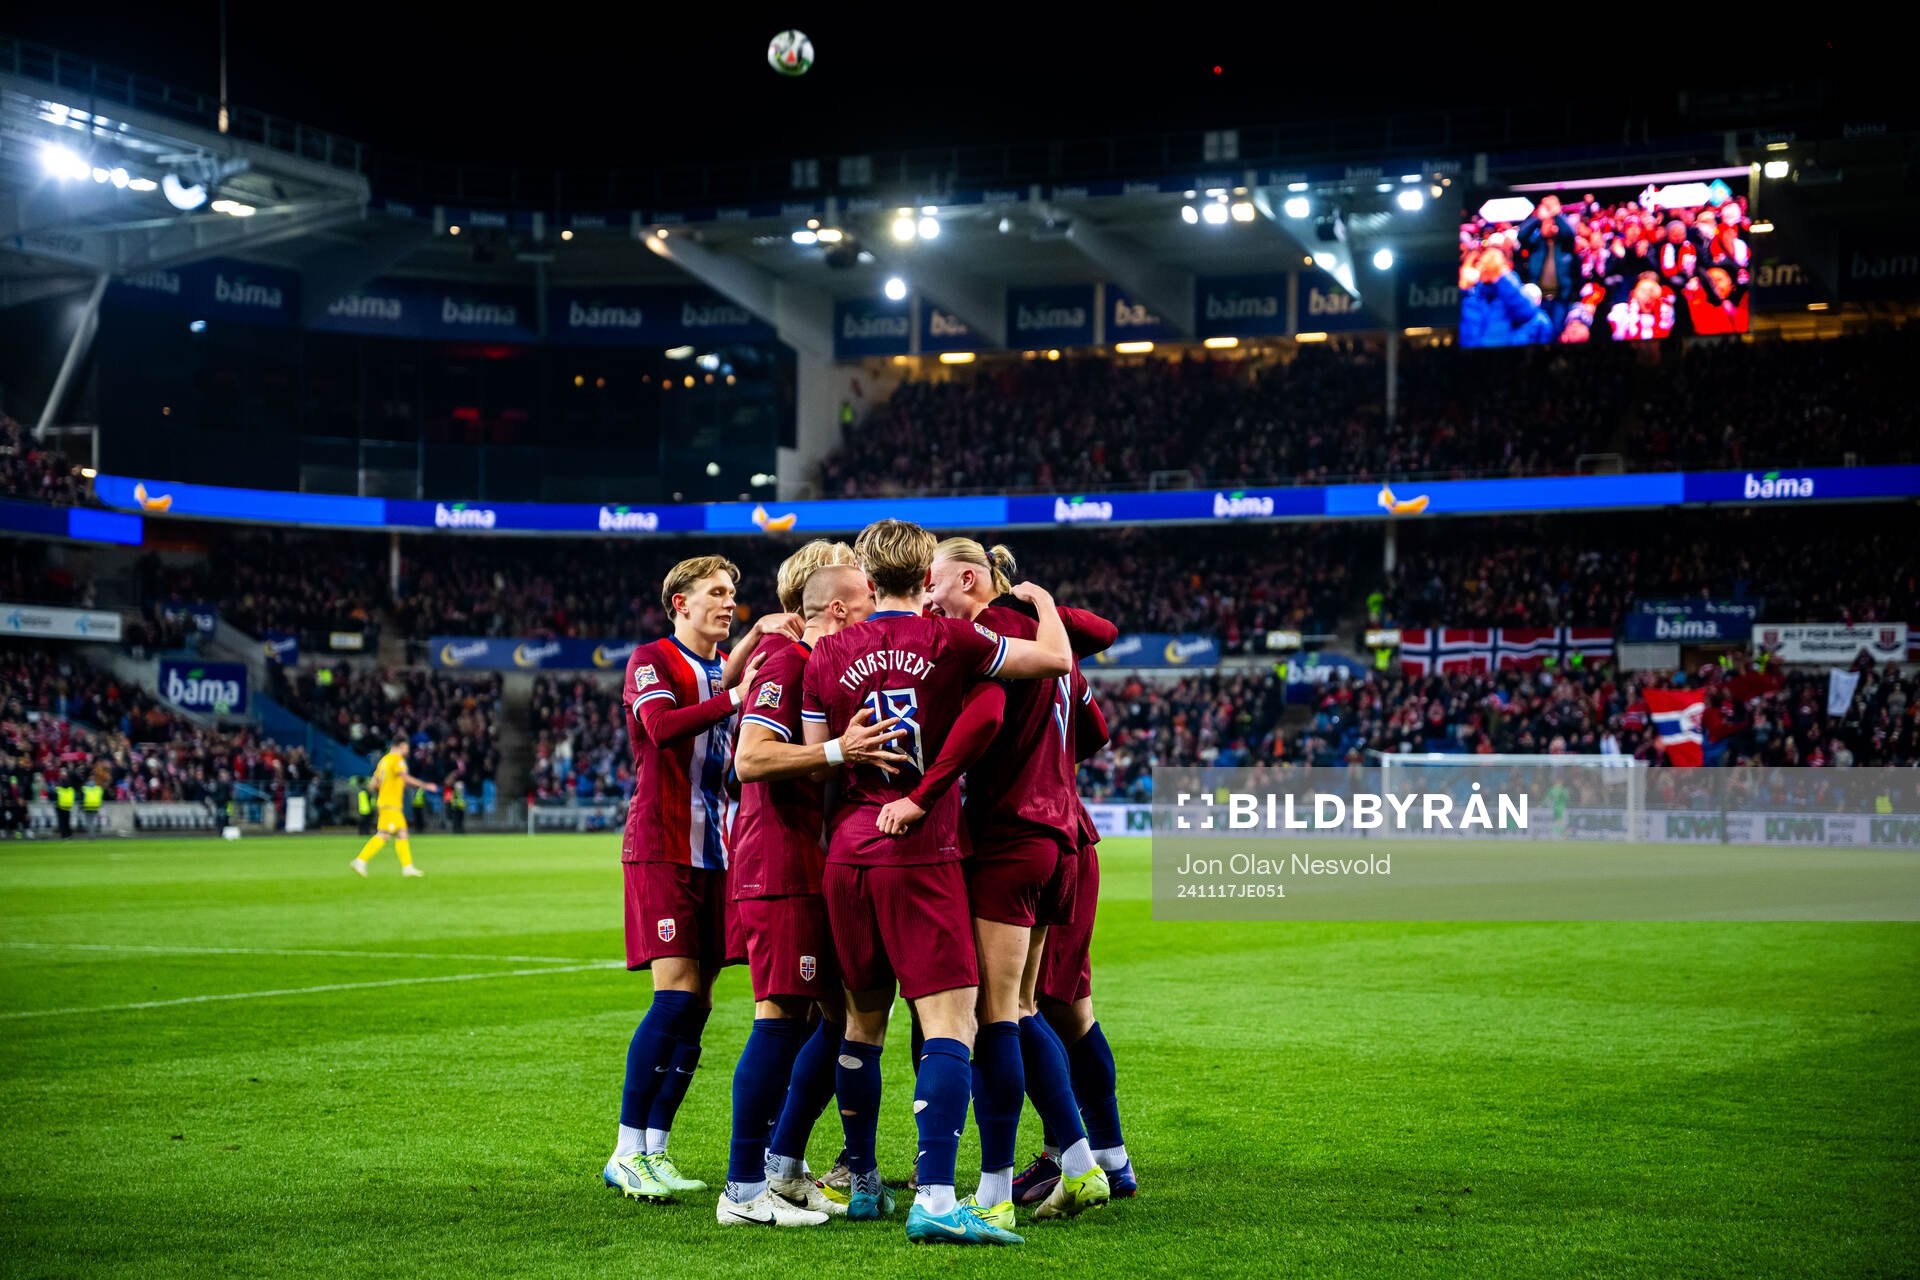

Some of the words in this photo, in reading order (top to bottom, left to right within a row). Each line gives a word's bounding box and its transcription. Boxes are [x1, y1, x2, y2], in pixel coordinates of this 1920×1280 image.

[214, 272, 284, 309] bama
[1206, 287, 1279, 319] bama
[441, 296, 517, 325] bama
[569, 300, 643, 328] bama
[1016, 303, 1087, 331] bama
[843, 312, 909, 340] bama
[1744, 473, 1814, 499] bama
[435, 502, 496, 529] bama
[599, 505, 658, 531] bama
[1054, 497, 1112, 521] bama
[1213, 492, 1274, 518] bama
[1655, 615, 1718, 640] bama
[839, 650, 935, 690] THORSTVEDT
[167, 667, 240, 707] bama
[864, 687, 925, 784] 18
